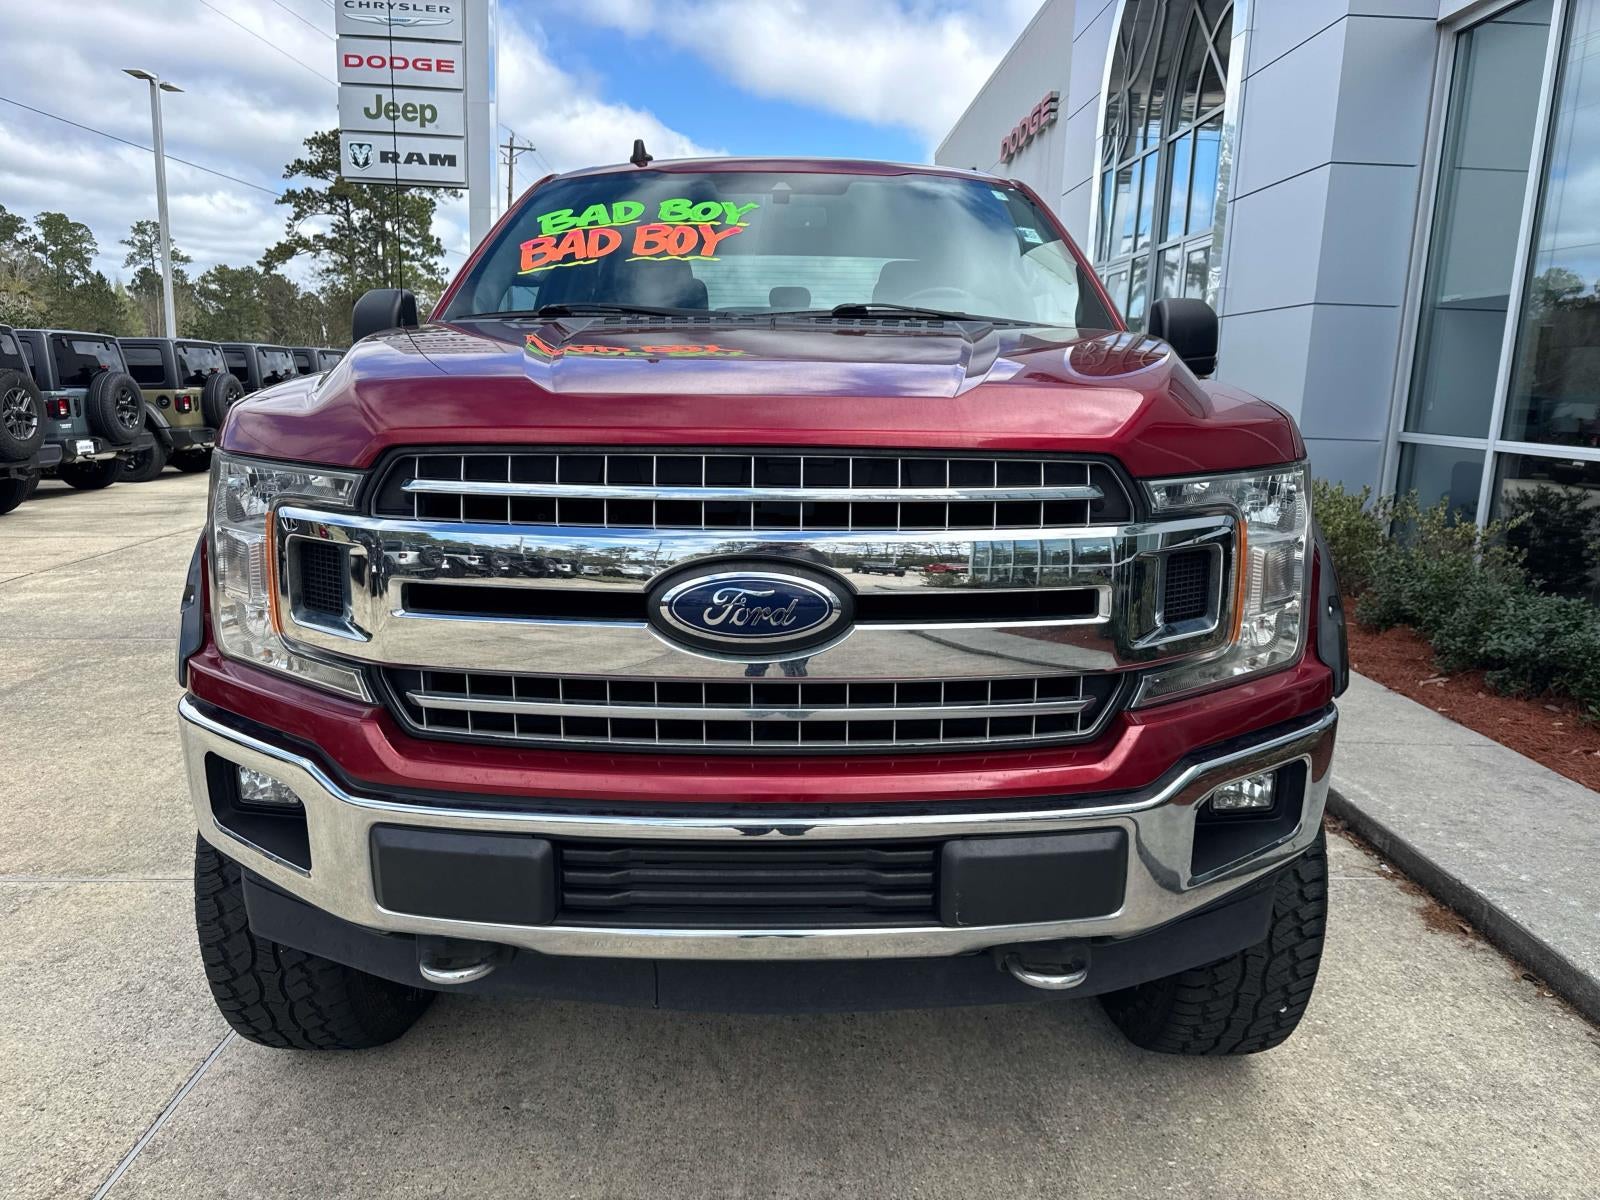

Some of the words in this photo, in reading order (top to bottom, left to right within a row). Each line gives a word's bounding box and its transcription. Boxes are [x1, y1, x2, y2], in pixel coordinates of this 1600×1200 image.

[344, 1, 451, 13] CHRYSLER
[344, 54, 455, 73] DODGE
[363, 94, 438, 128] Jeep
[1000, 91, 1058, 163] DODGE
[380, 150, 457, 167] RAM
[537, 201, 645, 235] BAD
[658, 198, 760, 225] BOY
[519, 227, 623, 271] BAD
[632, 224, 743, 257] BOY
[703, 587, 799, 626] Ford
